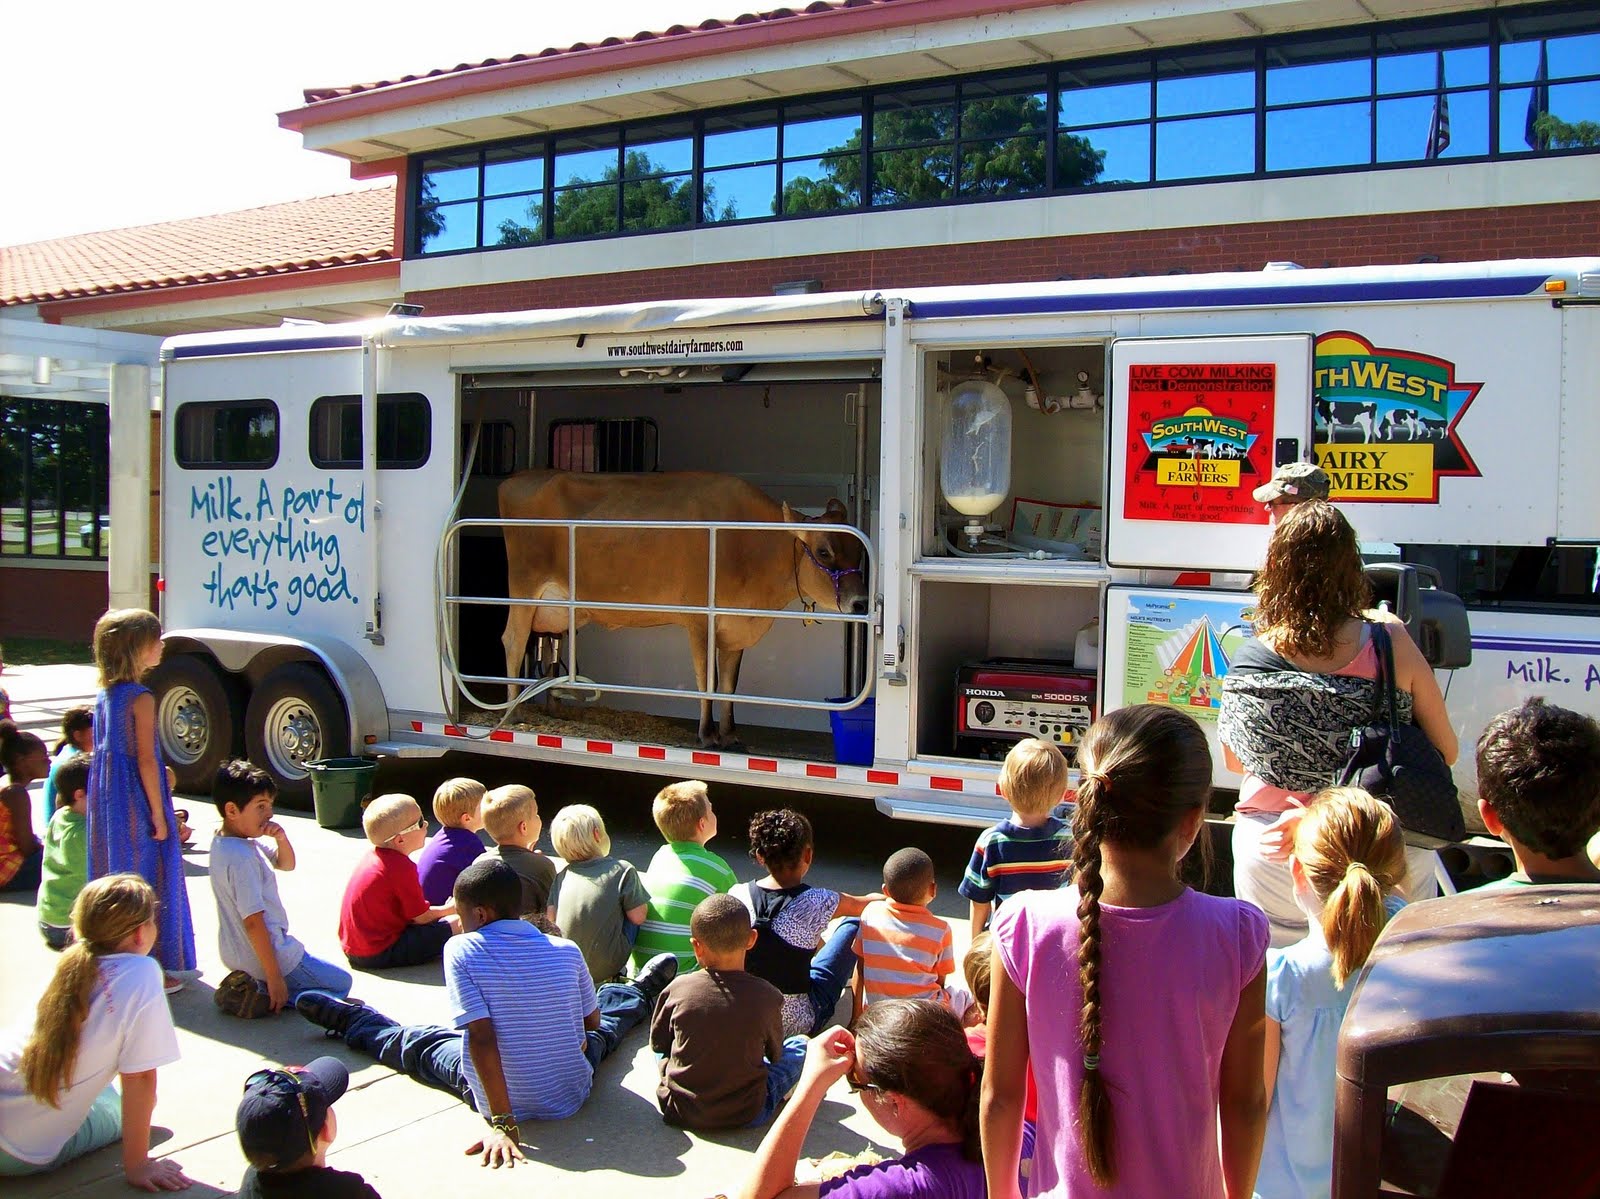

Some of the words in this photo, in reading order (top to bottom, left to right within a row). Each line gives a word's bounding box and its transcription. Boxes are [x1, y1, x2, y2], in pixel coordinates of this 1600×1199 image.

[607, 339, 743, 358] www.southwestdairyfarmers.com
[1131, 367, 1163, 378] LIVE
[1168, 367, 1205, 378] COW
[1209, 366, 1272, 378] MILKING
[1132, 380, 1163, 391] Next
[1167, 379, 1272, 391] Demonstration:
[1315, 361, 1447, 402] THWEST
[1178, 461, 1219, 473] DARY
[1168, 472, 1228, 483] FARMERS
[1328, 473, 1408, 491] MERS
[191, 476, 251, 523] Milk.
[257, 478, 274, 521] A
[283, 478, 343, 521] part
[202, 517, 340, 576] everything
[203, 562, 278, 611] that's
[287, 566, 358, 616] good.
[1507, 657, 1570, 683] Milk.
[1585, 664, 1600, 692] A
[966, 689, 1005, 697] HONDA
[1044, 693, 1088, 702] 5000SX
